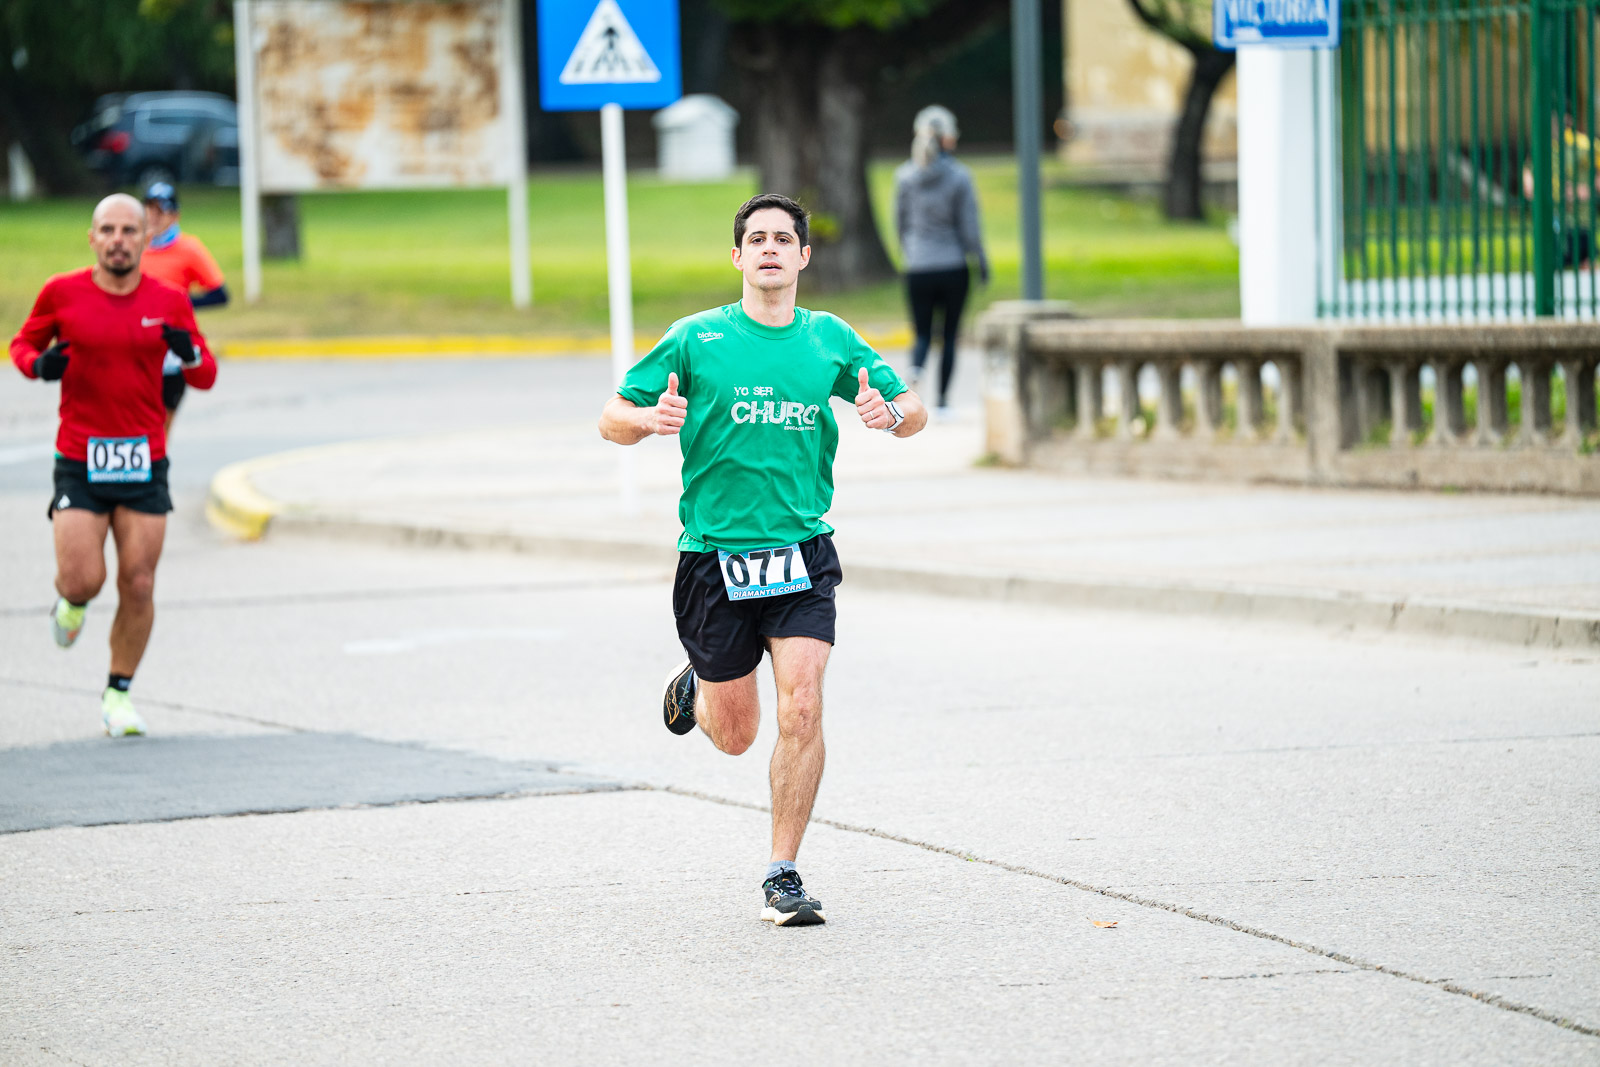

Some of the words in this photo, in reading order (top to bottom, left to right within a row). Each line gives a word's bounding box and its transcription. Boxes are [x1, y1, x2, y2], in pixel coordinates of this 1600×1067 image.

[734, 386, 749, 396] YO
[753, 386, 774, 396] SER
[731, 400, 820, 425] CHURO
[94, 442, 142, 470] 056
[726, 547, 793, 589] 077
[733, 588, 777, 599] DIAMANTE
[778, 582, 807, 593] CORRE
